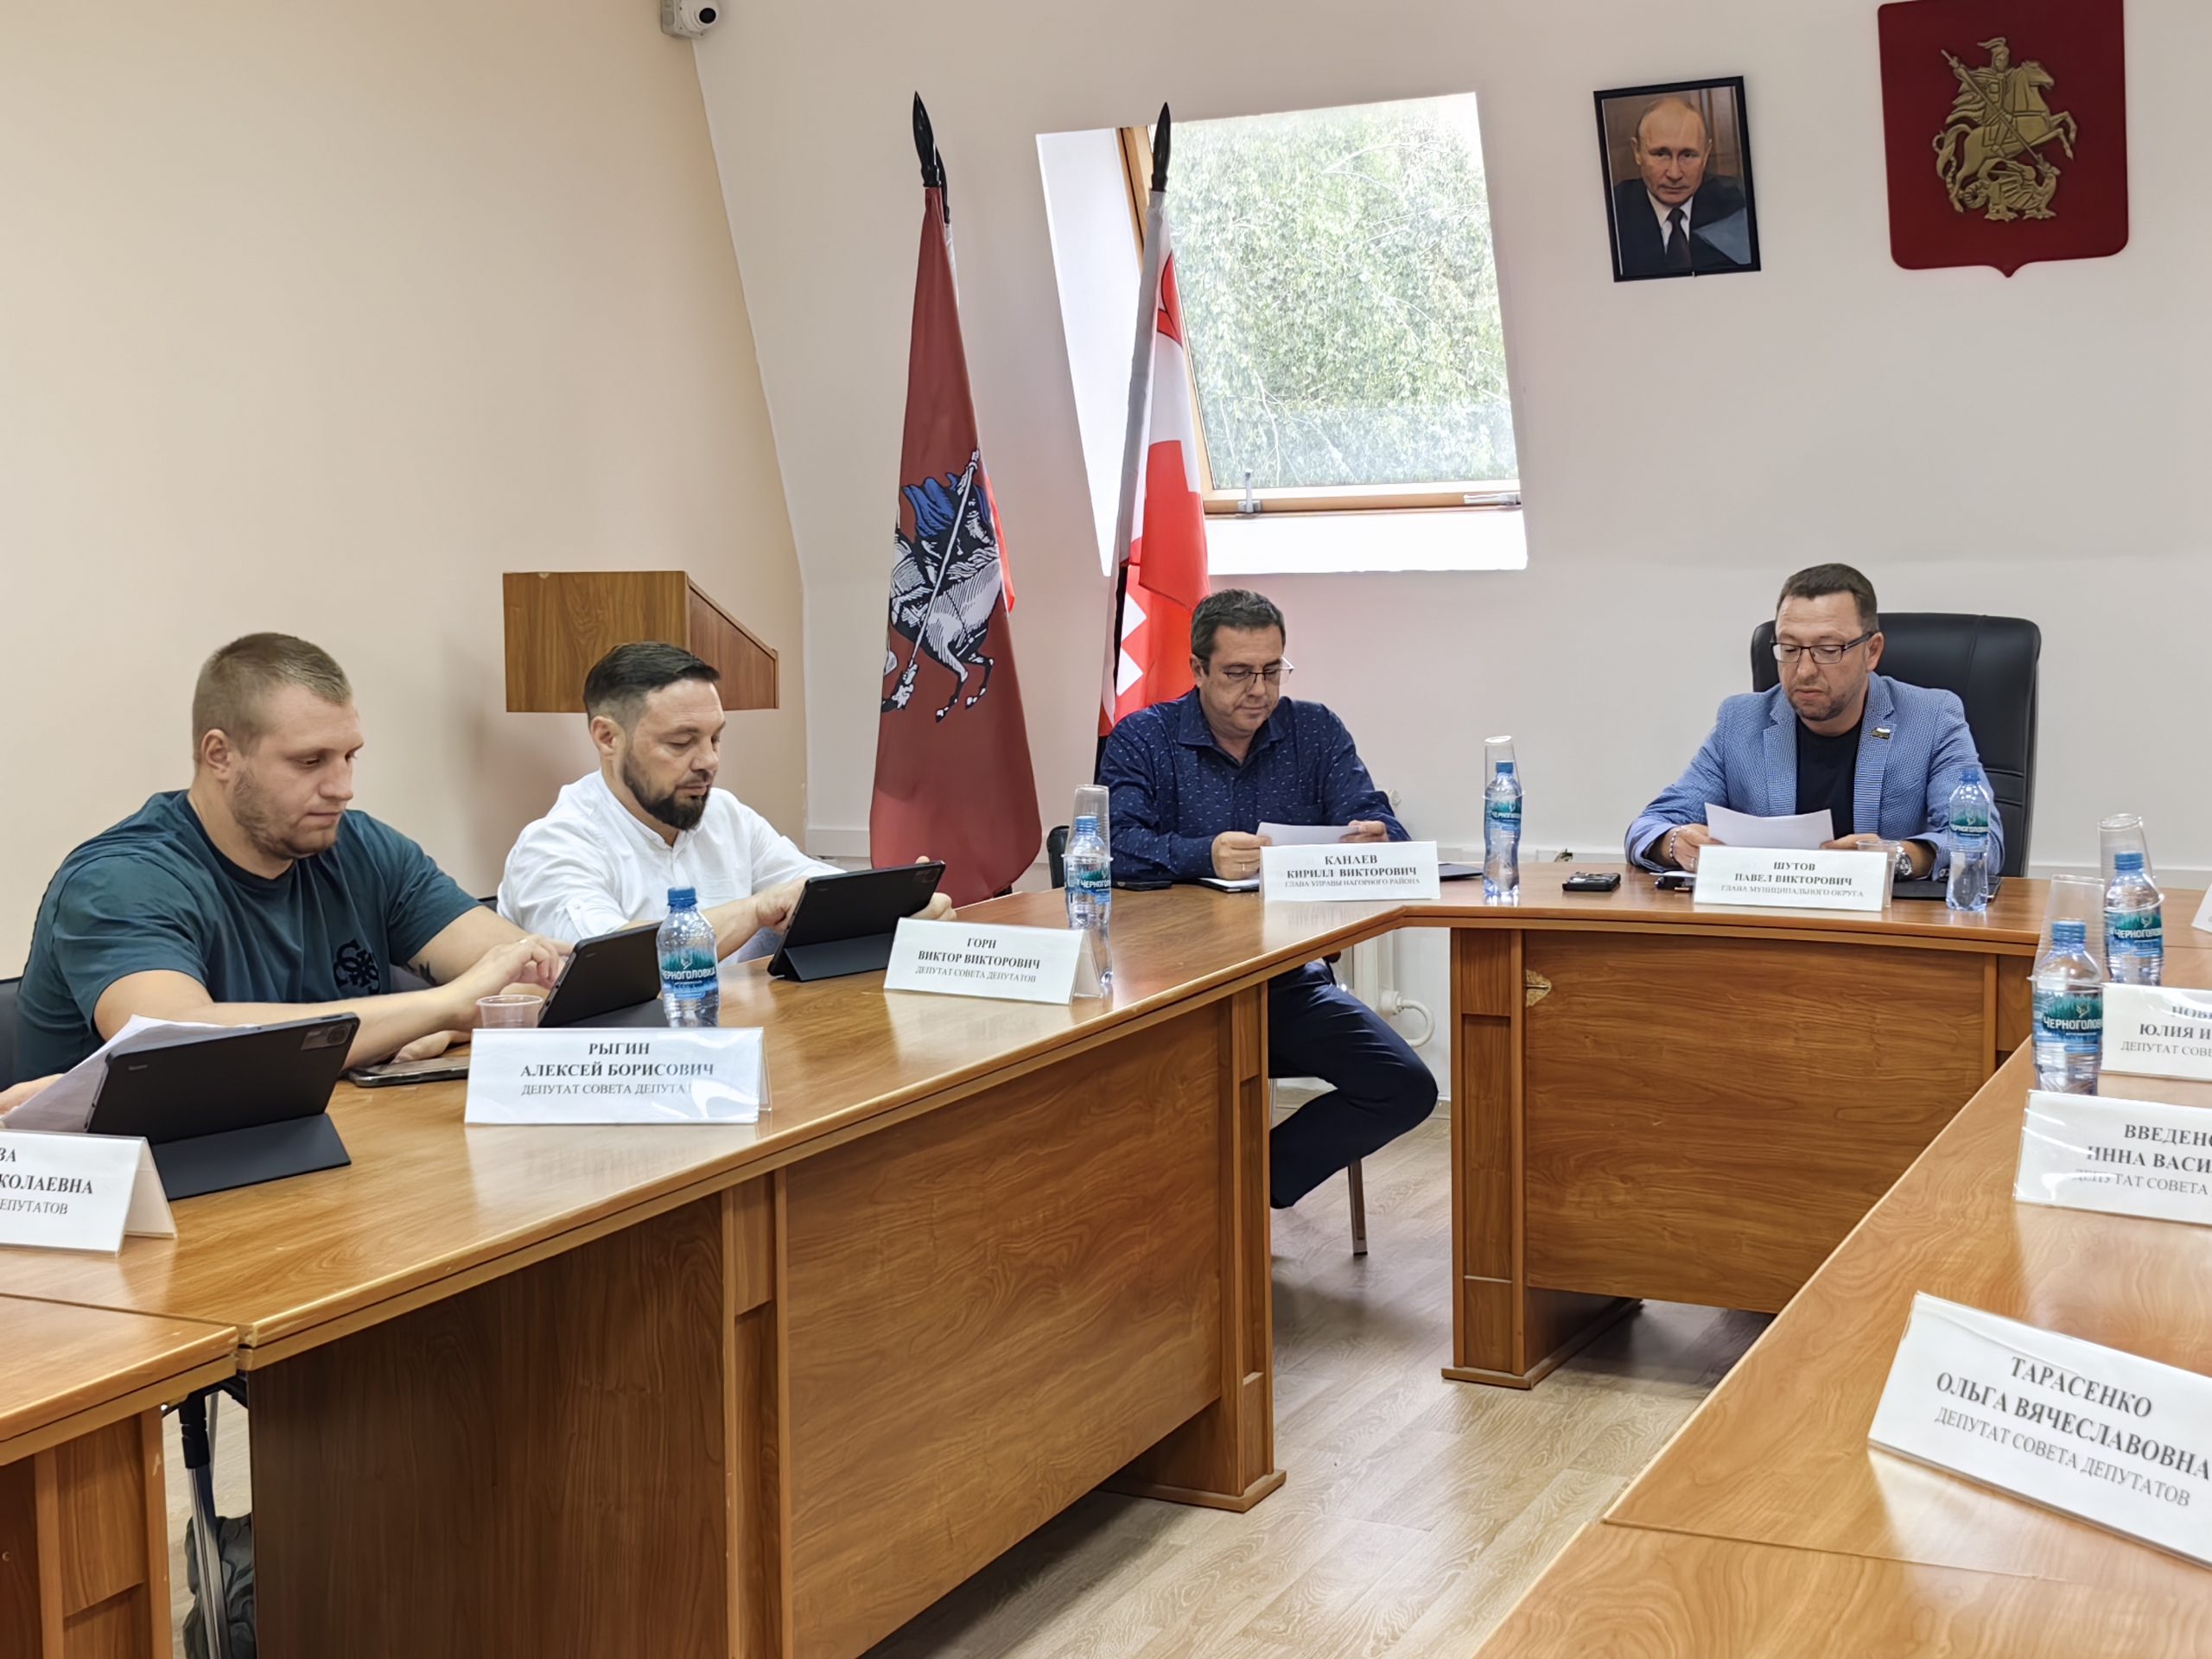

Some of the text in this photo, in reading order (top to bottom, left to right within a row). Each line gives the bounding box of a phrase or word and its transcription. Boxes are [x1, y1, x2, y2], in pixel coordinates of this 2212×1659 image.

[1325, 855, 1377, 865] КАНАЕВ
[1773, 861, 1815, 871] ШУТОВ
[1287, 867, 1417, 879] КИРИЛЛ ВИКТОРОВИЧ
[1734, 873, 1853, 886] ПАВЕЛ ВИКТОРОВИЧ
[1389, 877, 1421, 886] РАЙОНА
[1721, 884, 1864, 898] ГЛАВА МУНИЦИПАЛЬНОГО ОКРУГА
[967, 938, 996, 949] ГОРН
[918, 950, 1040, 969] ВИКТОР ВИКТОРОВИЧ
[915, 966, 1037, 982] ДЕПУТАТ СОВЕТА ДЕПУТАТОВ
[2139, 1023, 2194, 1039] ЮЛИЯ
[588, 1042, 650, 1055] РЫГИН
[2120, 1040, 2178, 1054] ДЕПУТАТ
[520, 1061, 714, 1077] АЛЕКСЕЙ БОРИСОВИЧ
[521, 1084, 692, 1096] ДЕПУТАТ СОВЕТА ДЕПУТА
[2087, 1146, 2146, 1166] ИННА
[2146, 1178, 2209, 1196] СОВЕТА
[2011, 1356, 2152, 1418] ТАРАСЕНКО
[1936, 1372, 2210, 1481] ОЛЬГА ВЯЧЕСЛАВОВНА
[1934, 1407, 2191, 1507] ДЕПУТАТ СОВЕТА ДЕПУТАТОВ
